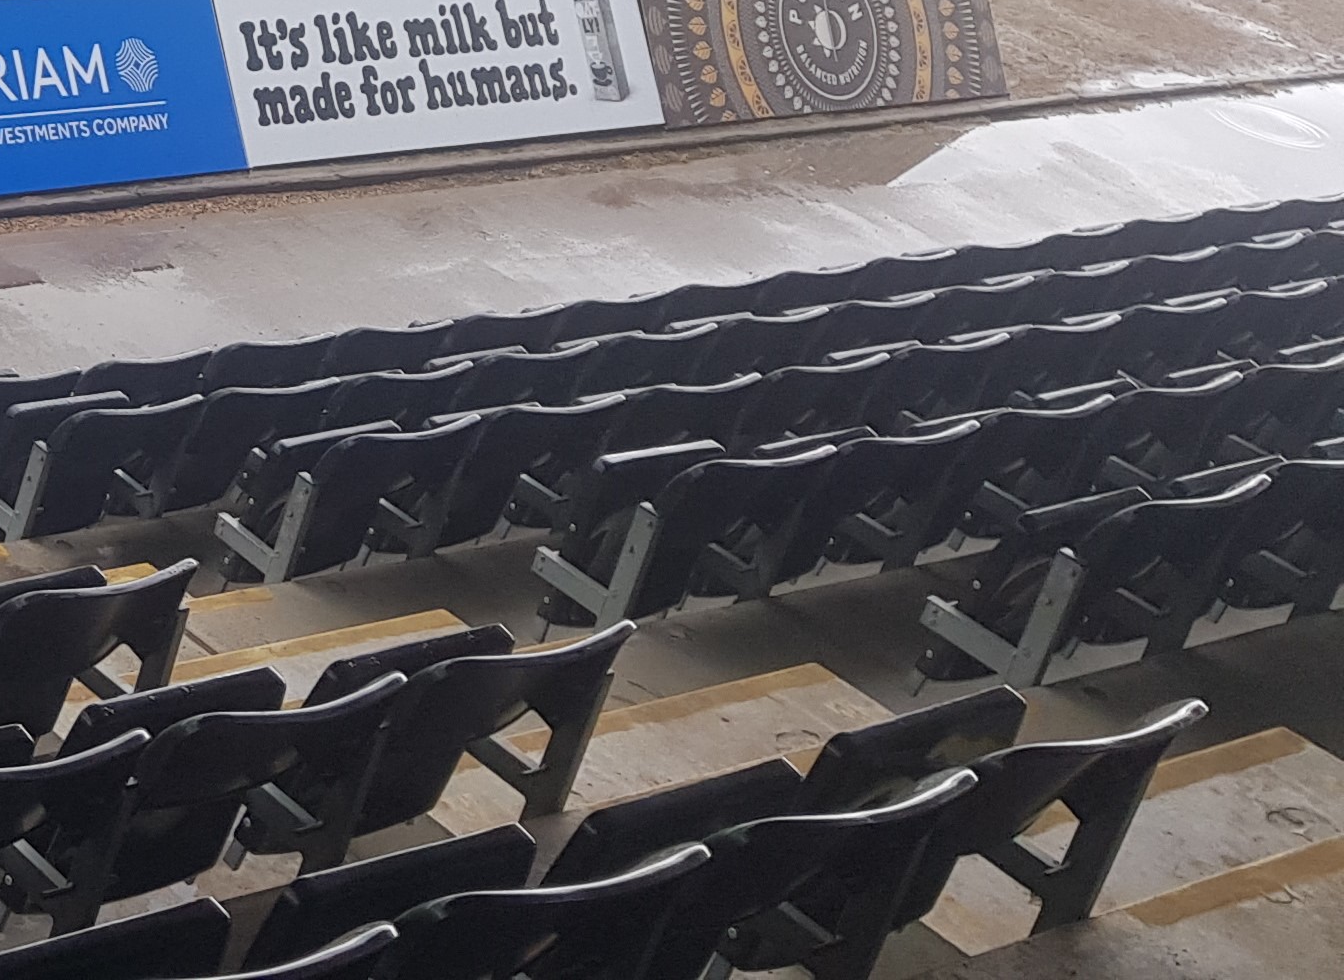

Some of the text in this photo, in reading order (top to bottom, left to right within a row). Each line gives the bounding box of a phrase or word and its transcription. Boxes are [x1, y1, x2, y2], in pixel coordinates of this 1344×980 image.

[239, 18, 309, 72] It's
[313, 11, 398, 66] like
[404, 2, 498, 59] milk
[796, 39, 869, 86] BALANCED NUTRITION
[252, 58, 578, 126] made for humans.
[92, 113, 169, 137] COMPANY
